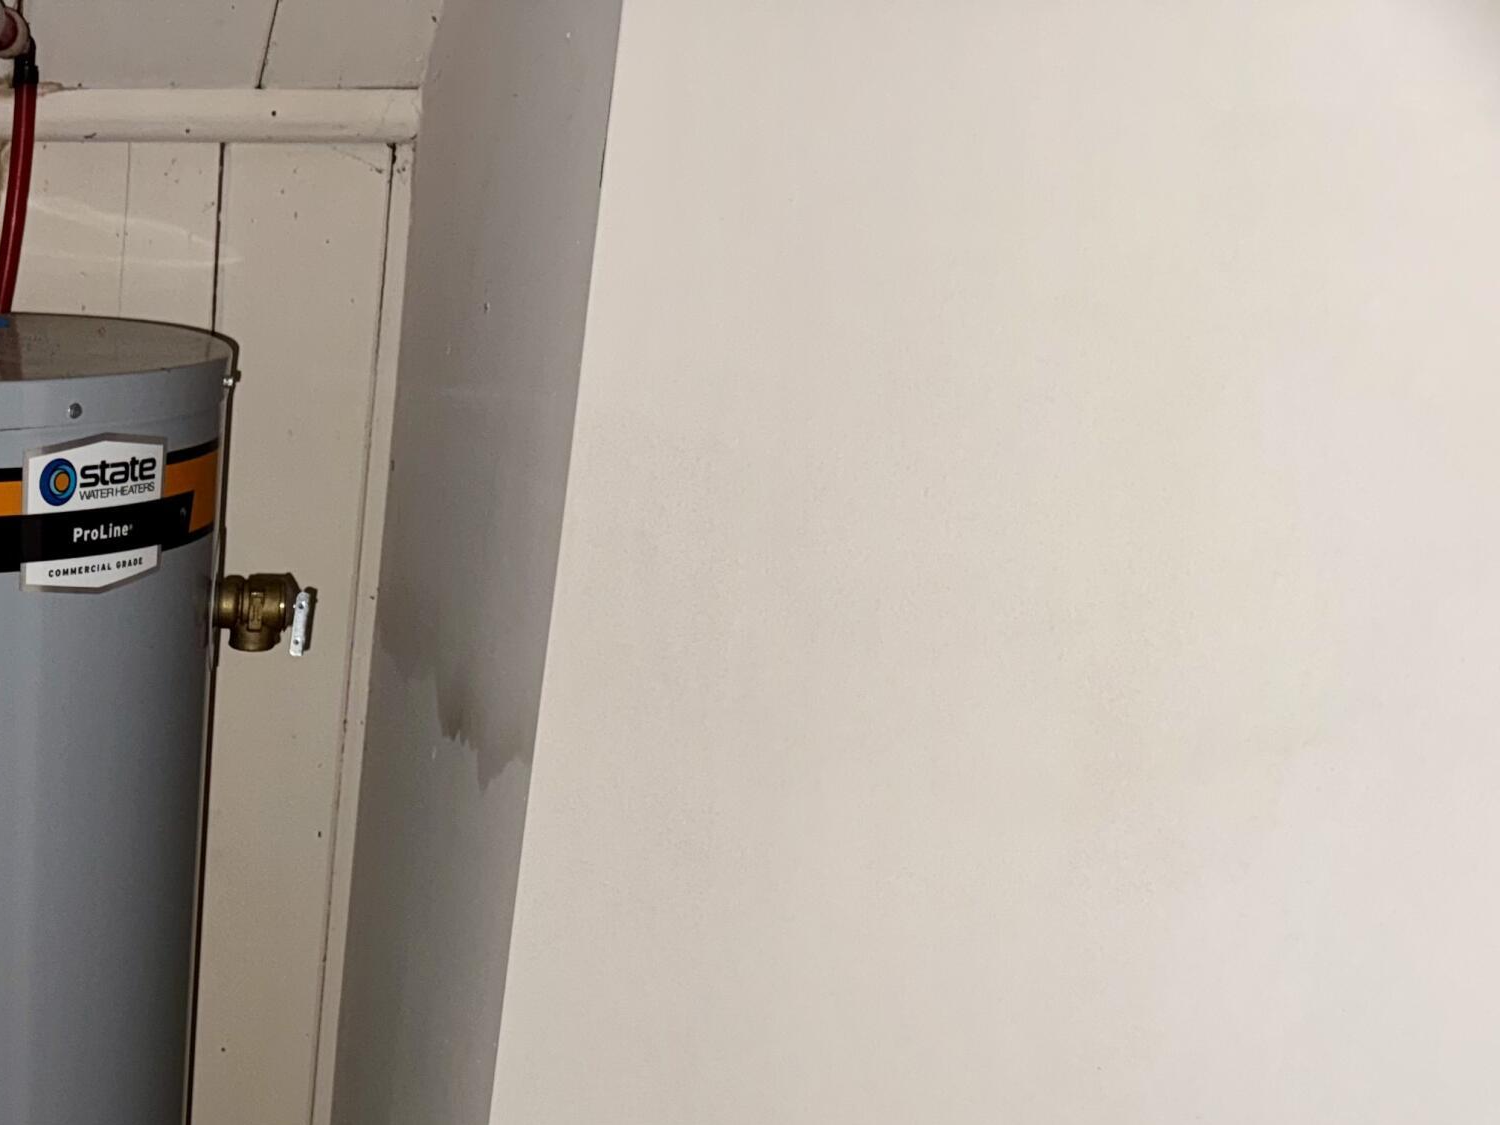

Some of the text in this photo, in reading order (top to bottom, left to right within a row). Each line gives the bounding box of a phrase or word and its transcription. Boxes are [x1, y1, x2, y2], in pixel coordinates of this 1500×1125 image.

[79, 456, 157, 489] state
[79, 481, 156, 501] WATER HEATERS
[48, 557, 144, 578] COMMERCIAL GRADE
